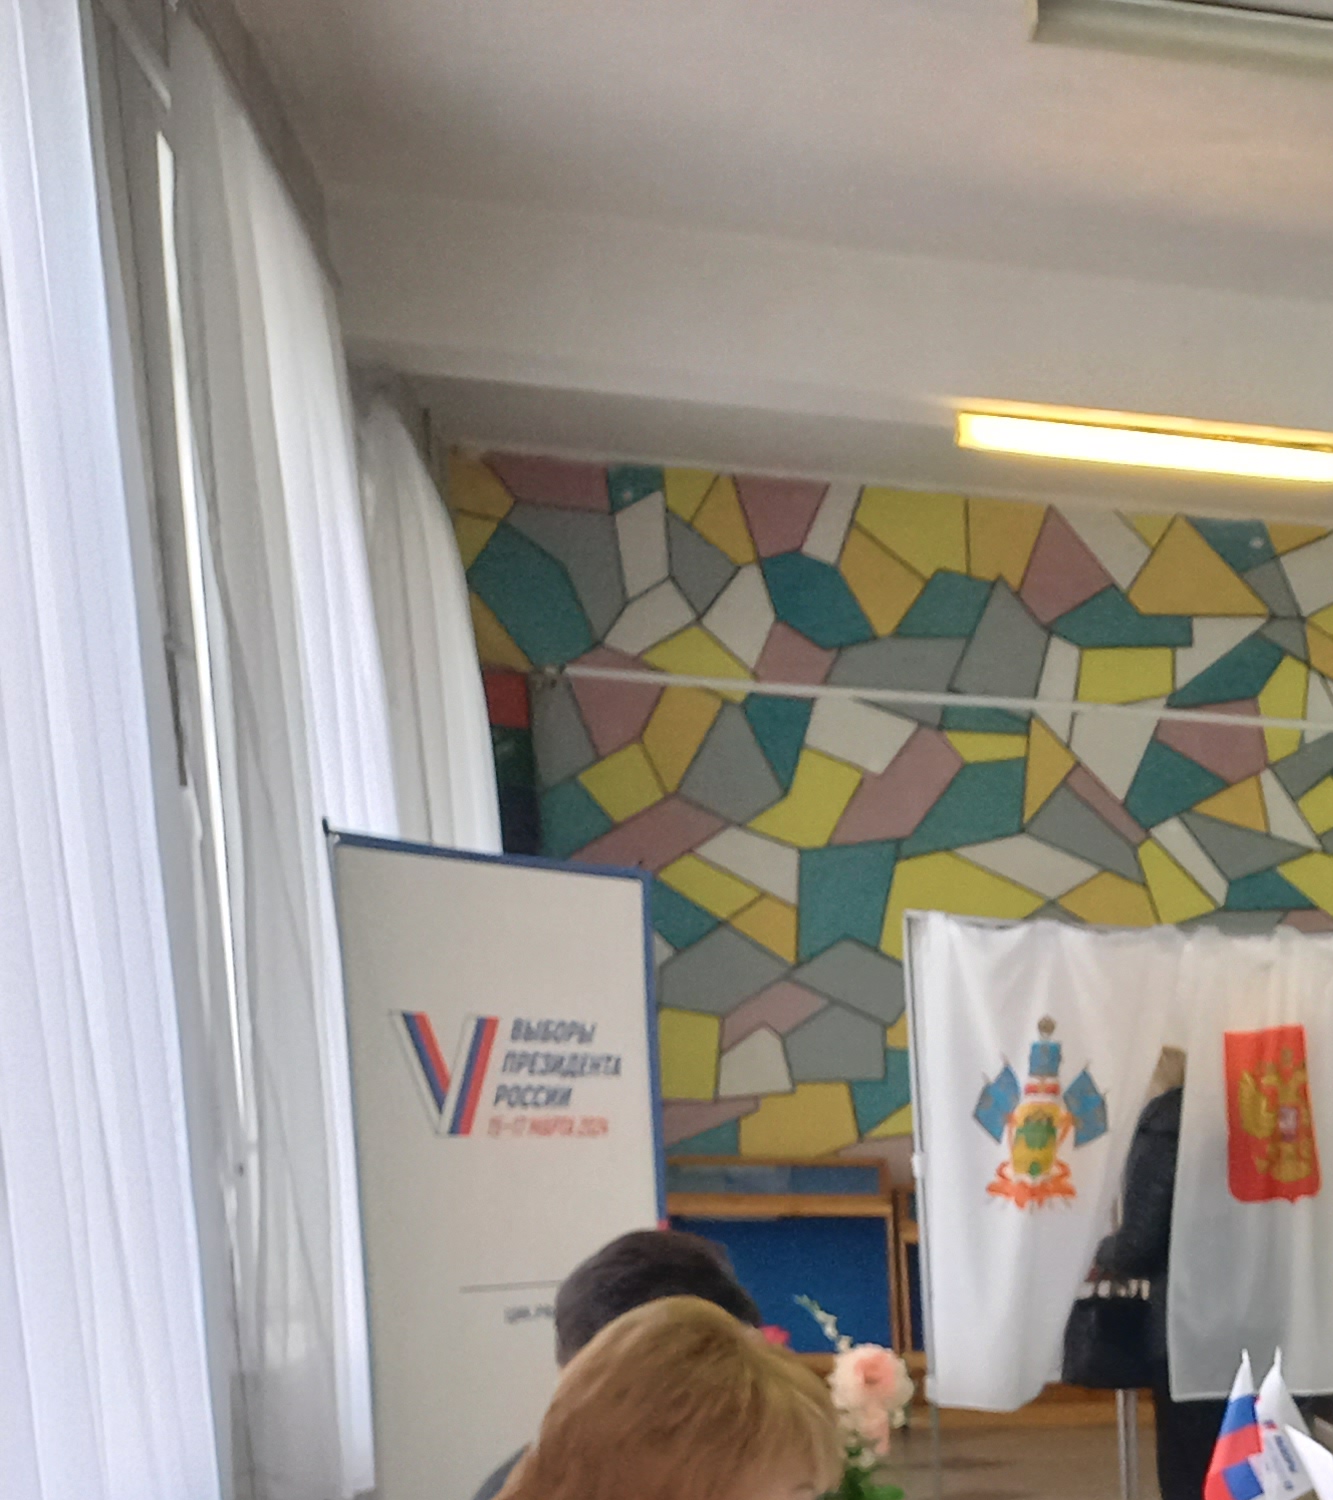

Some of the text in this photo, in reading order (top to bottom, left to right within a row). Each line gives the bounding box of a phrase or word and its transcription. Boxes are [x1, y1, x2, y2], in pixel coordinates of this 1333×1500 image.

[511, 1017, 597, 1044] ВЫБОРЫ
[502, 1051, 622, 1078] ПРЕЗИДЕНТА
[493, 1084, 573, 1109] РОССИИ
